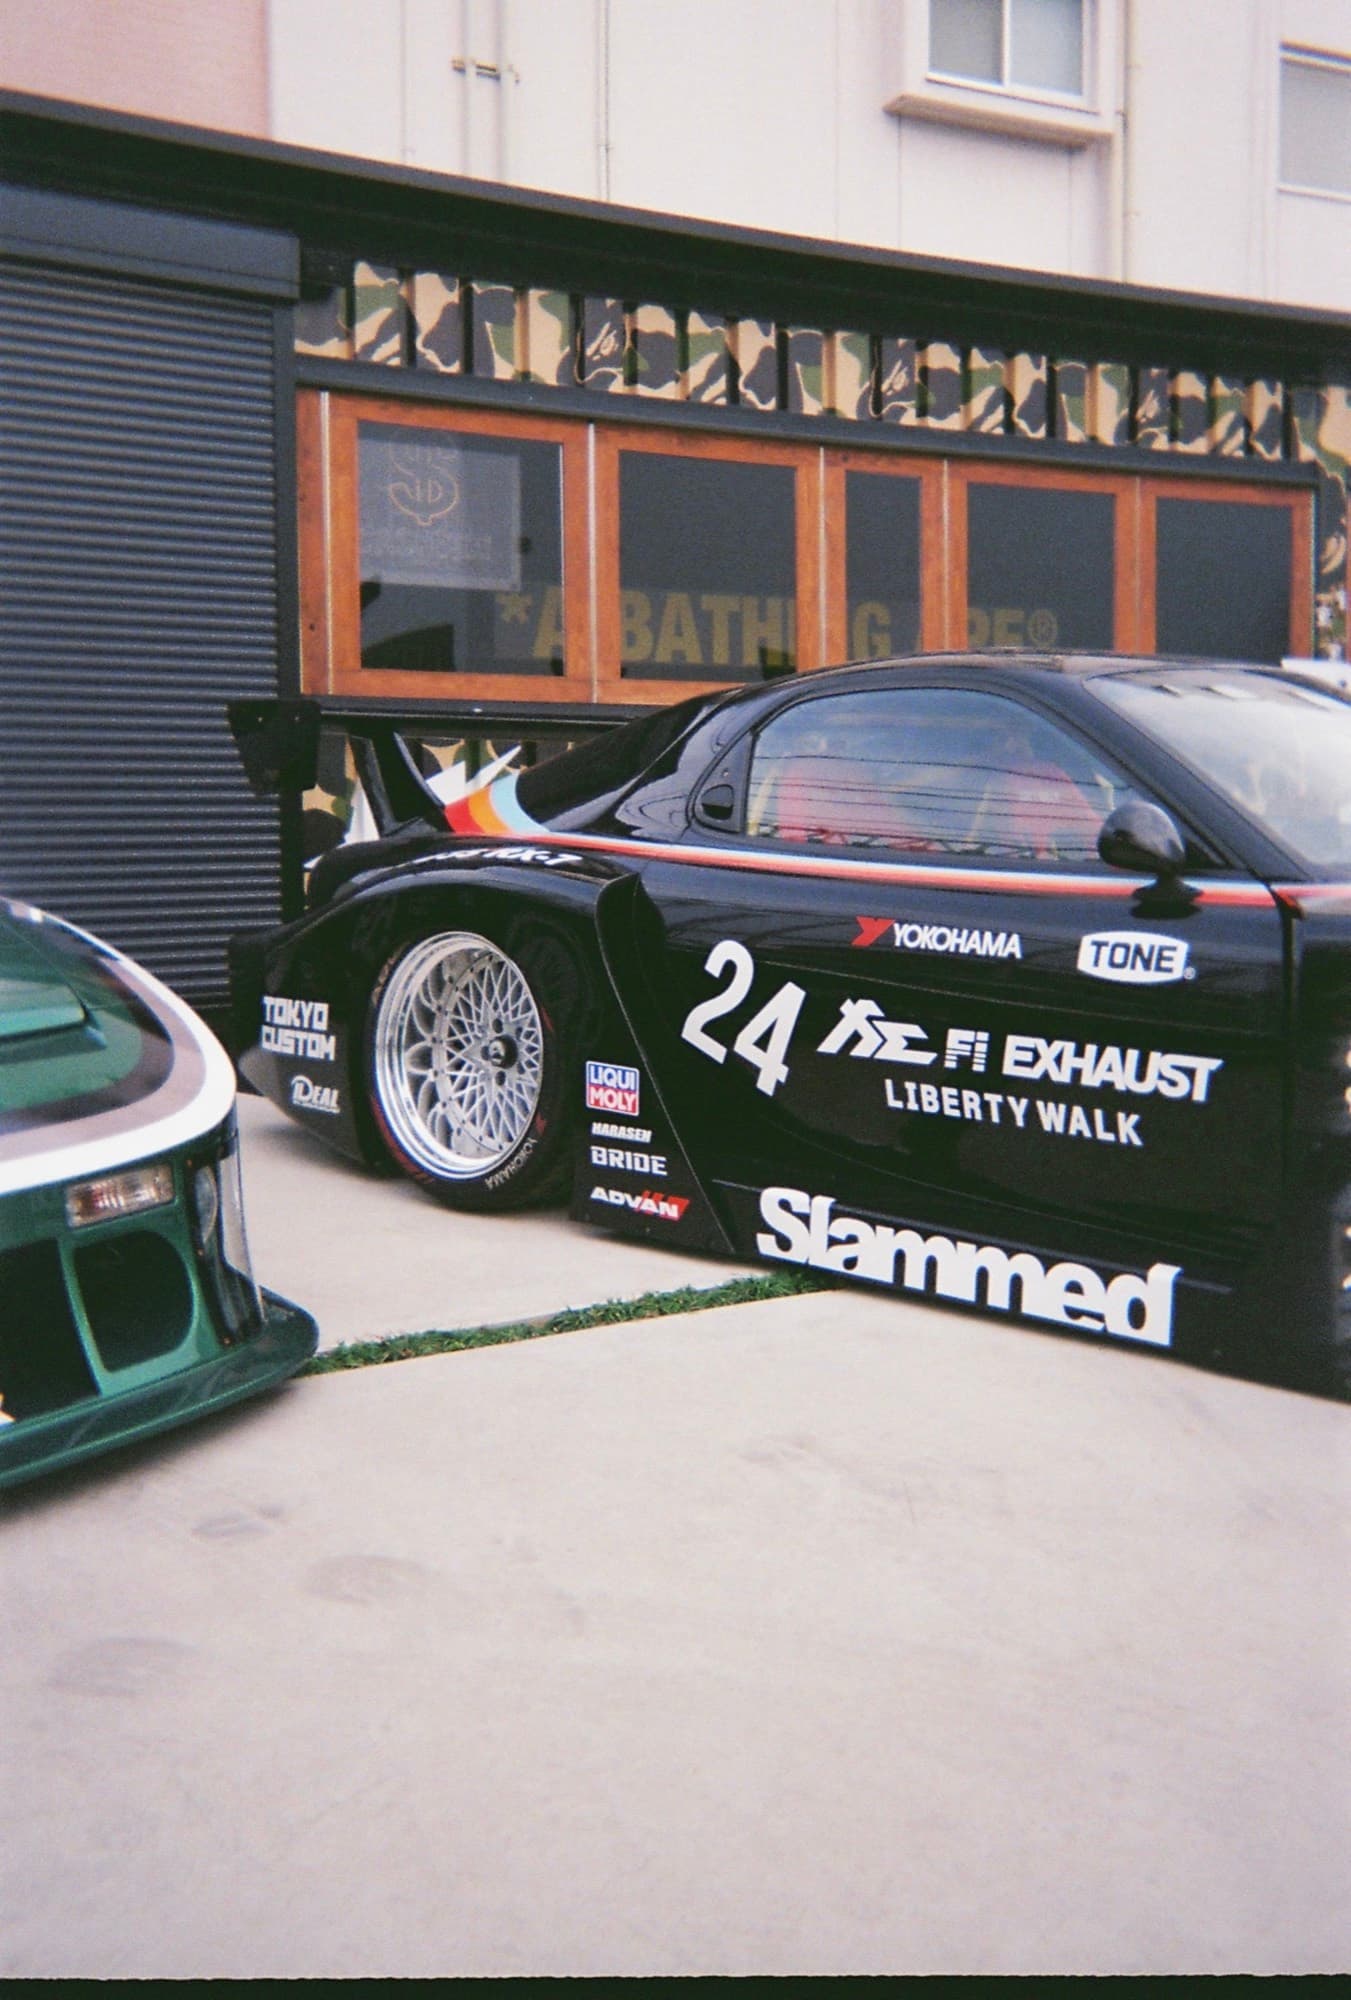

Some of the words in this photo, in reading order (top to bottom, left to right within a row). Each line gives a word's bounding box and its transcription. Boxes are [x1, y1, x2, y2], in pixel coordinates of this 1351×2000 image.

[892, 922, 1023, 960] YOKOHAMA
[263, 996, 329, 1031] TOKYO
[681, 939, 806, 1097] 24
[261, 1025, 336, 1062] CUSTOM
[590, 1064, 635, 1091] LIQUI
[1002, 1033, 1224, 1103] EXHAUST
[590, 1086, 637, 1113] MOLY
[885, 1078, 1029, 1129] LIBERTY
[1037, 1101, 1144, 1148] WALK
[589, 1145, 668, 1176] BRIDE
[590, 1186, 685, 1220] ADVAN
[756, 1186, 1184, 1348] Slammed
